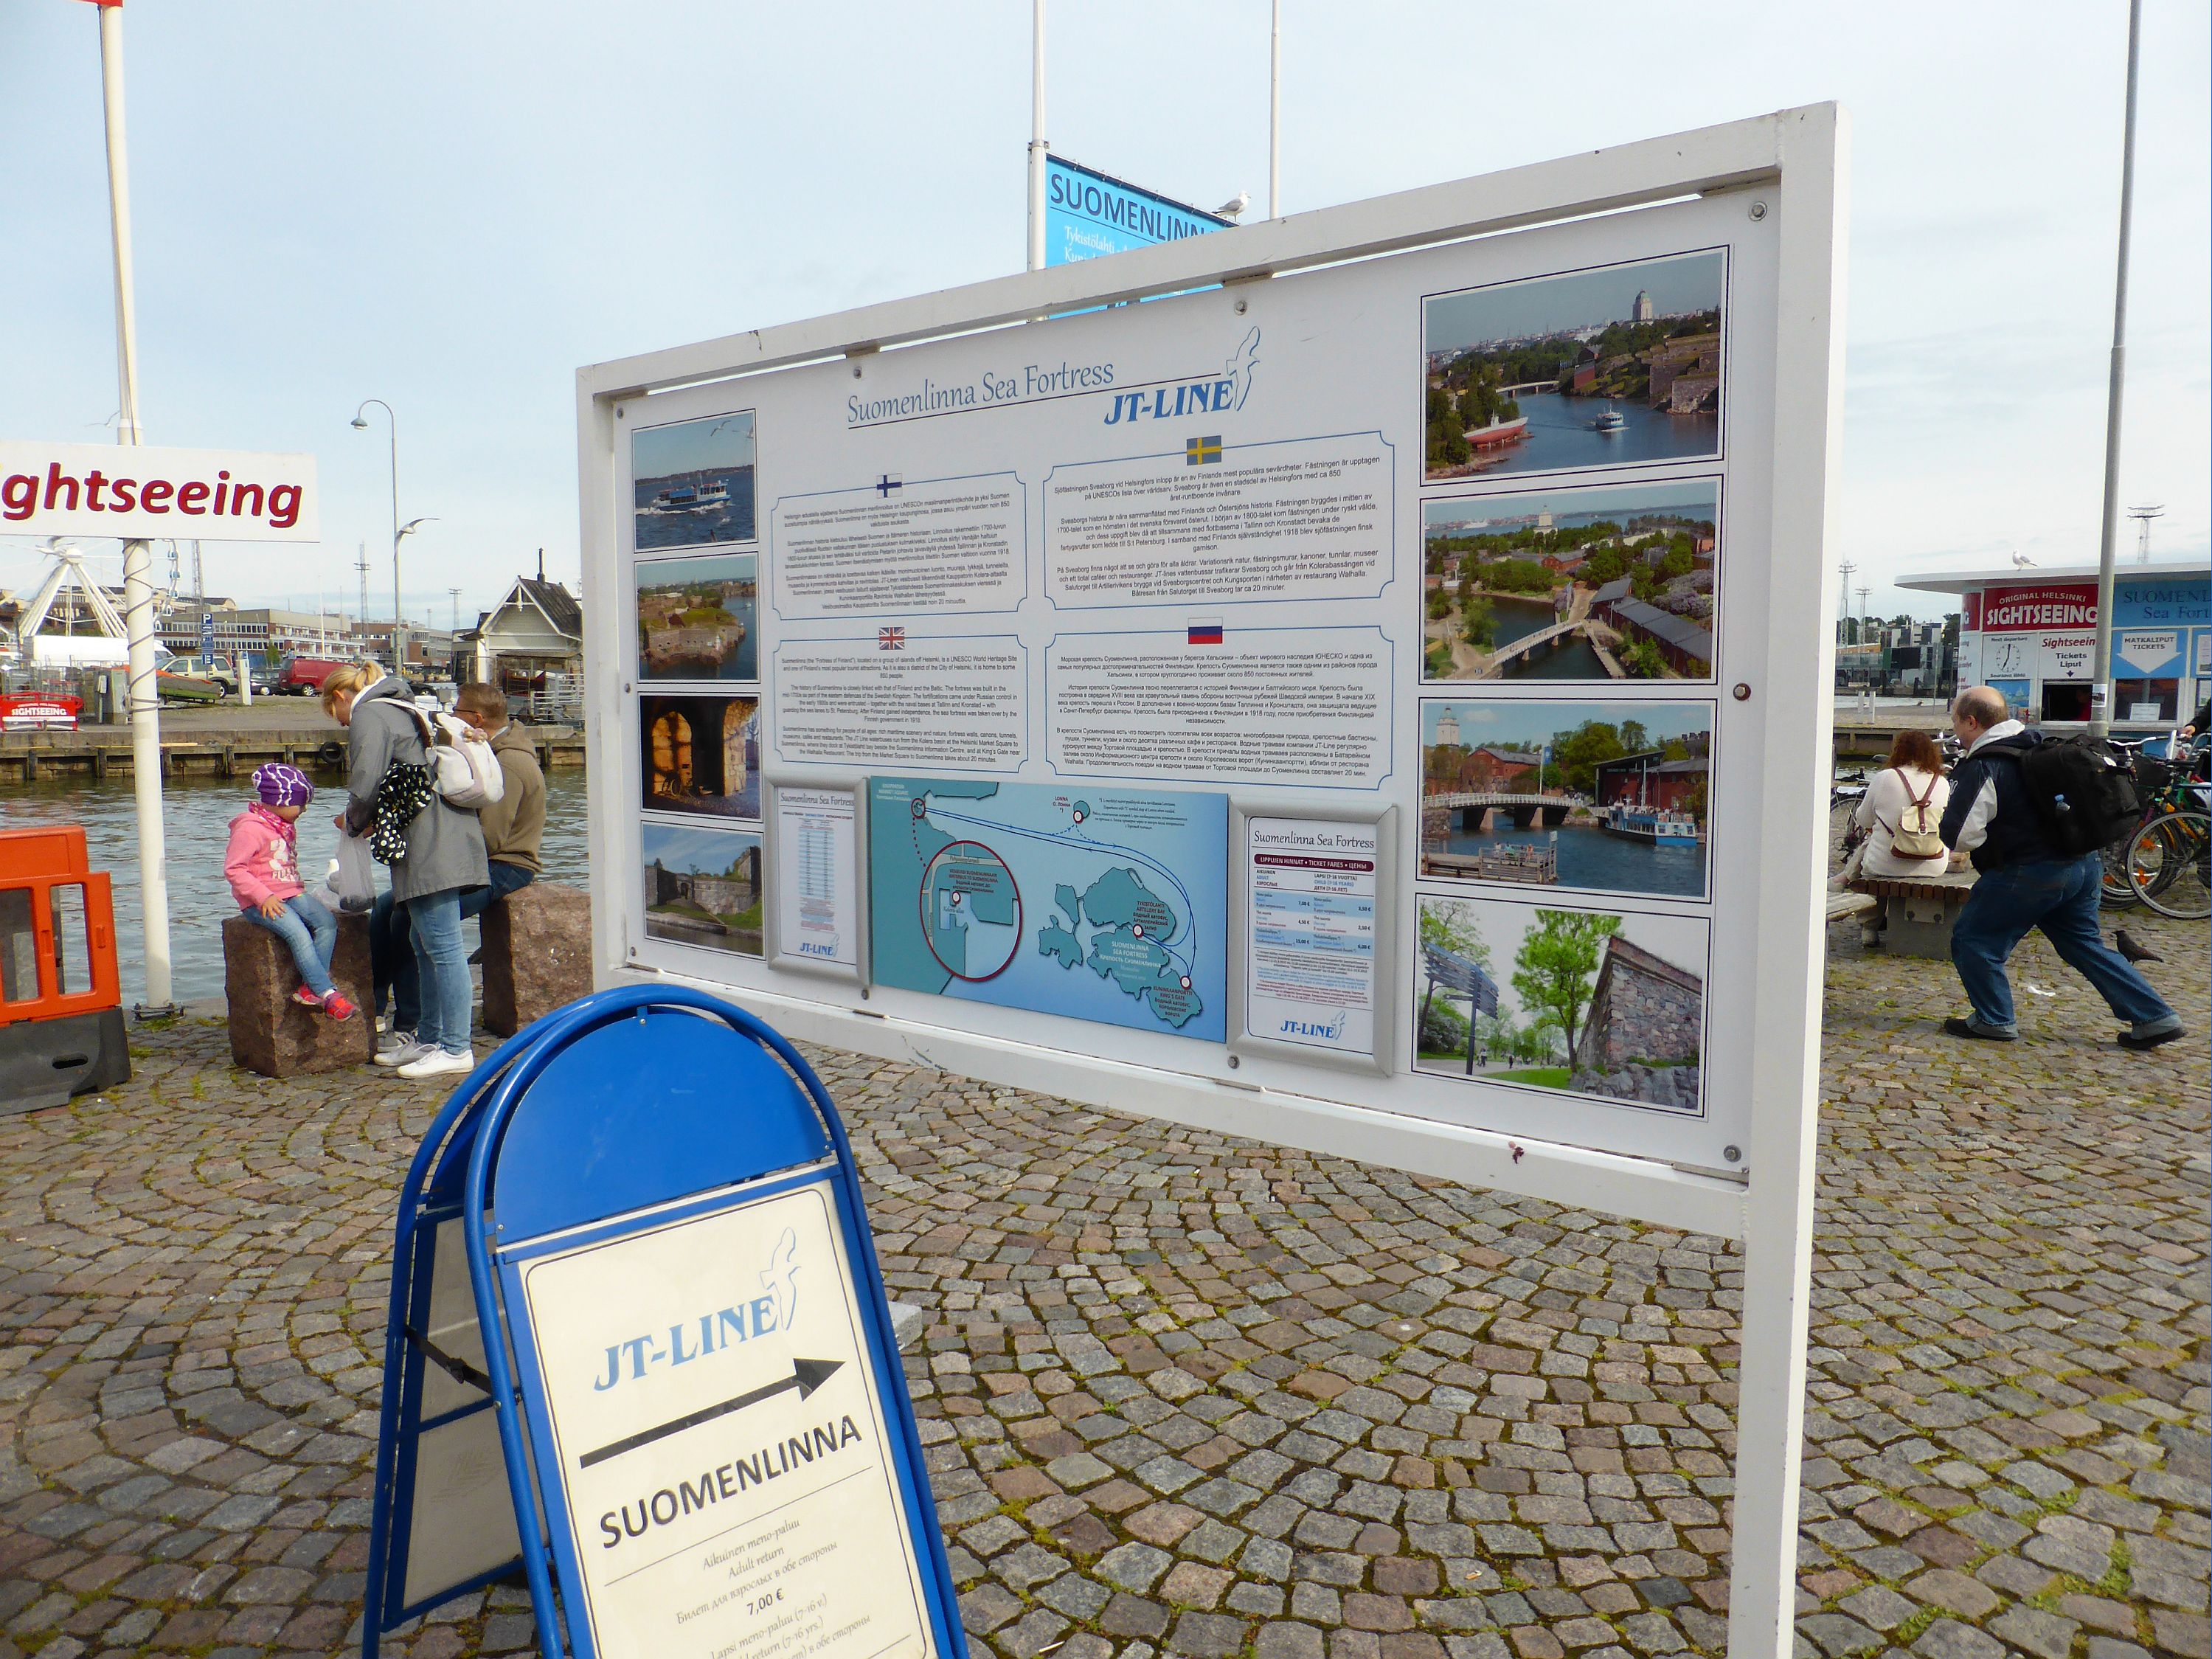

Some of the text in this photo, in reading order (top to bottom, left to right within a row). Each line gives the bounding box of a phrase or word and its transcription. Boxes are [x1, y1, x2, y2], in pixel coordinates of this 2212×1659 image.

[1050, 173, 1213, 242] SUOMENLIN
[1064, 226, 1114, 254] Tykistölahti
[847, 362, 1114, 423] Suomenlinna Sea Fortress
[1104, 380, 1234, 426] JT-LINE
[2000, 592, 2087, 604] ORIGINAL HELSINKI
[1987, 604, 2098, 625] SIGHTSEEING
[2143, 606, 2169, 619] Sea
[2042, 637, 2095, 649] Sightseein
[819, 795, 830, 805] Sea
[1254, 831, 1375, 849] Suomenlinna Sea Fortress
[1260, 856, 1283, 865] LIPPUJEN
[800, 943, 834, 957] JT-LINE
[1112, 941, 1150, 952] SUOMENLINNA
[1123, 949, 1148, 959] FORTRESS
[1280, 1019, 1334, 1039] JT-LINE
[594, 1295, 779, 1392] JT-LINE
[600, 1415, 863, 1549] SUOMENLINNA
[702, 1517, 801, 1570] Aikuinen meno-paluu
[728, 1547, 785, 1579] Adult return
[676, 1541, 838, 1625] Билет для взрослых в обе стороны
[746, 1588, 785, 1617] 7,00 €
[739, 1614, 794, 1647] meno-paluu
[794, 1599, 817, 1621] (7-16
[817, 1593, 828, 1610] v.)
[782, 1628, 804, 1649] (7-16
[805, 1616, 825, 1638] yrs.)
[808, 1646, 815, 1655] в
[815, 1633, 831, 1651] обе
[832, 1614, 871, 1641] стороны
